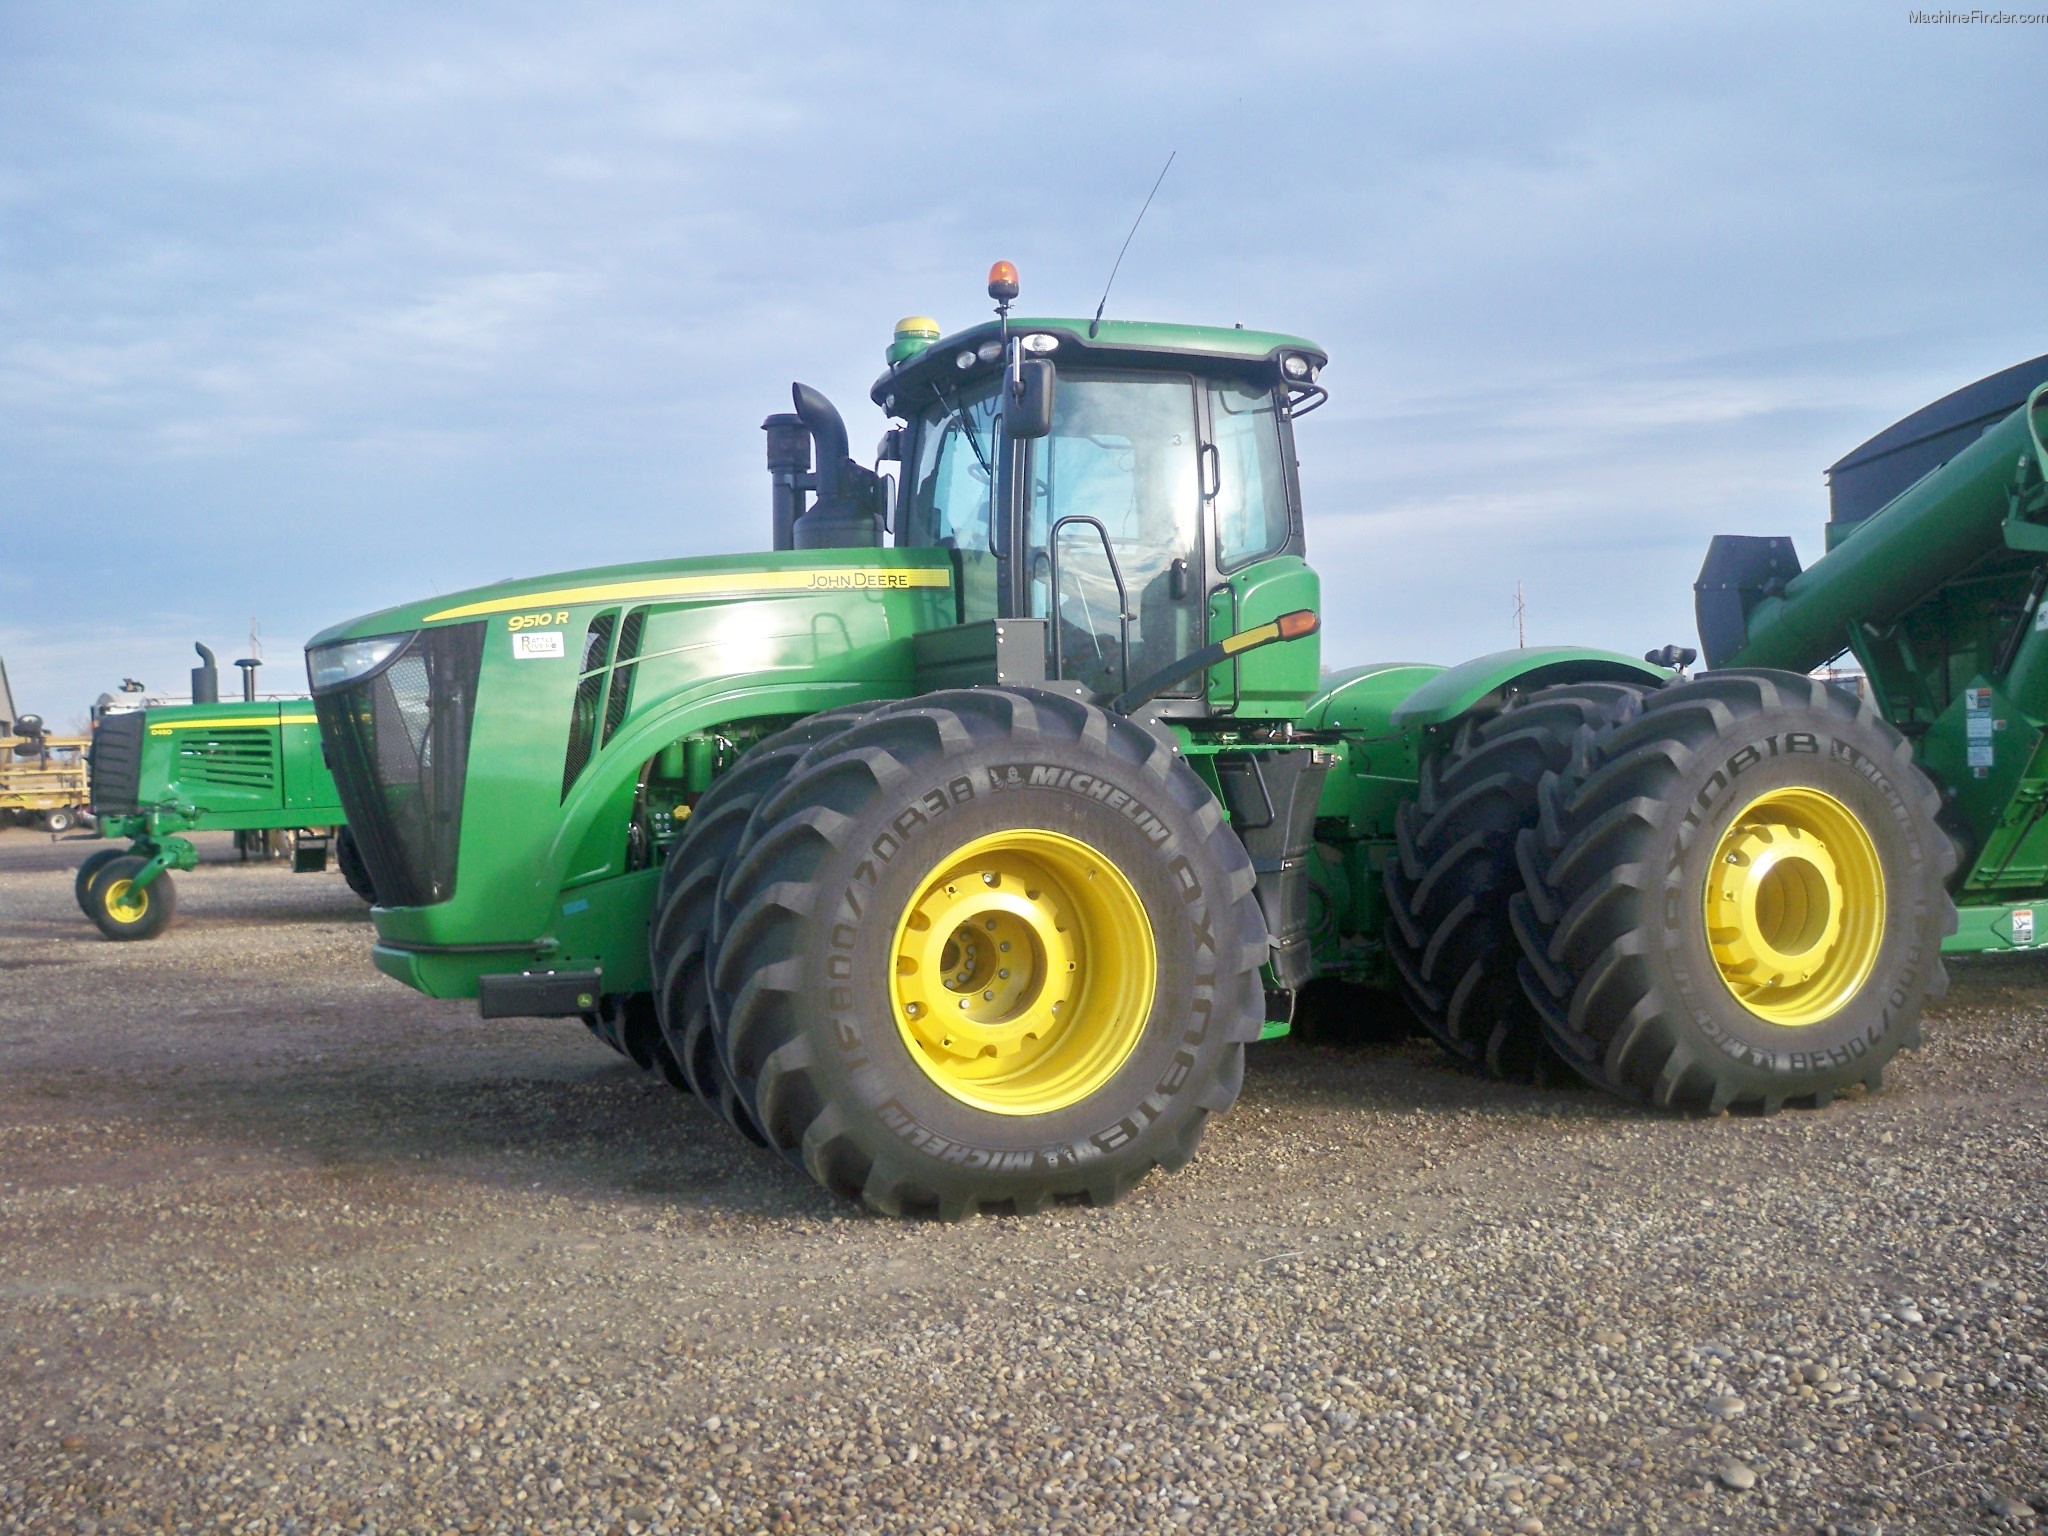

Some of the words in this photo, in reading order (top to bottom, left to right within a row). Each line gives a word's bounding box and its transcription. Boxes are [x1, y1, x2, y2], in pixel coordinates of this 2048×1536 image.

[807, 573, 851, 587] JOHN
[854, 572, 908, 587] DEERE
[508, 612, 553, 632] 9510
[555, 611, 569, 625] R
[1029, 764, 1172, 842] MICHELIN
[876, 1104, 1036, 1170] MICHELIN
